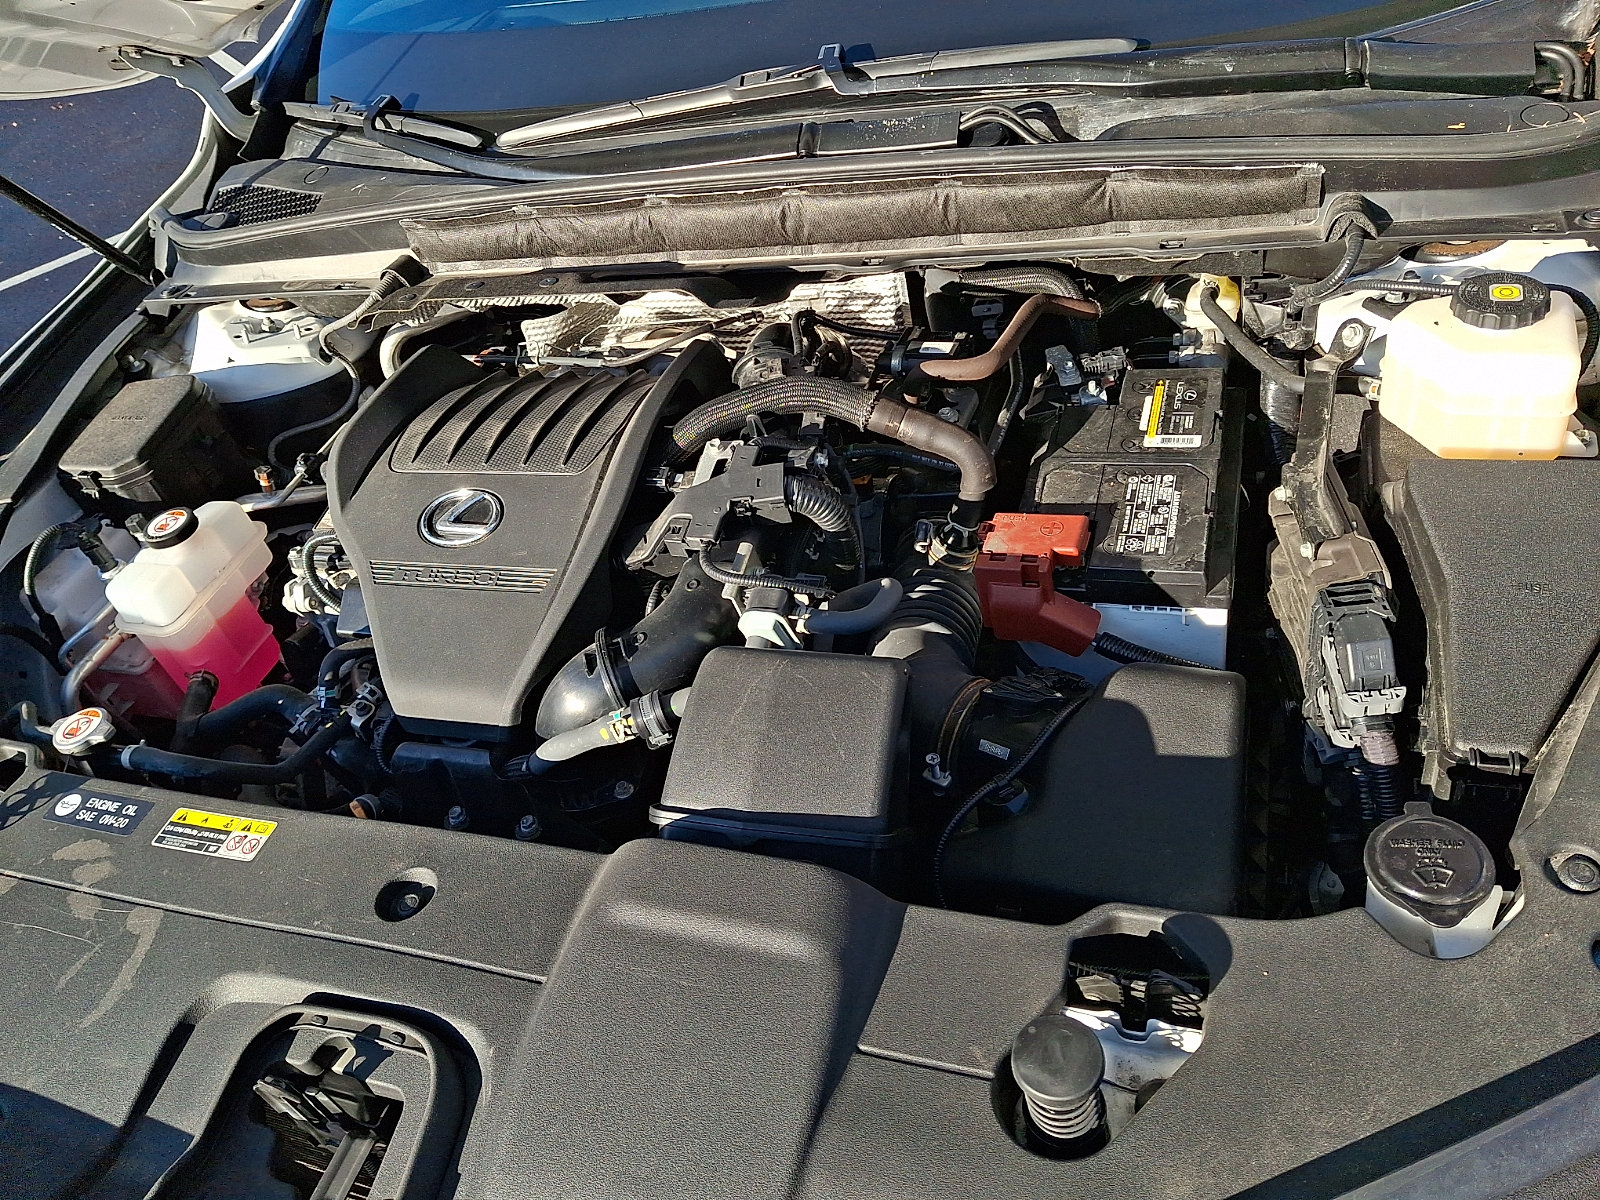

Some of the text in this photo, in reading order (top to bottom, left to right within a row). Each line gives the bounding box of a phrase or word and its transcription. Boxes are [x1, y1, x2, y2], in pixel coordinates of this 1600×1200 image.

[1173, 381, 1185, 410] LEXUS
[398, 566, 497, 586] TURBO
[85, 797, 139, 817] ENGINE OIL
[75, 809, 130, 829] SAE 0W-20
[1389, 838, 1431, 848] WASHER
[1415, 847, 1442, 857] ONLY
